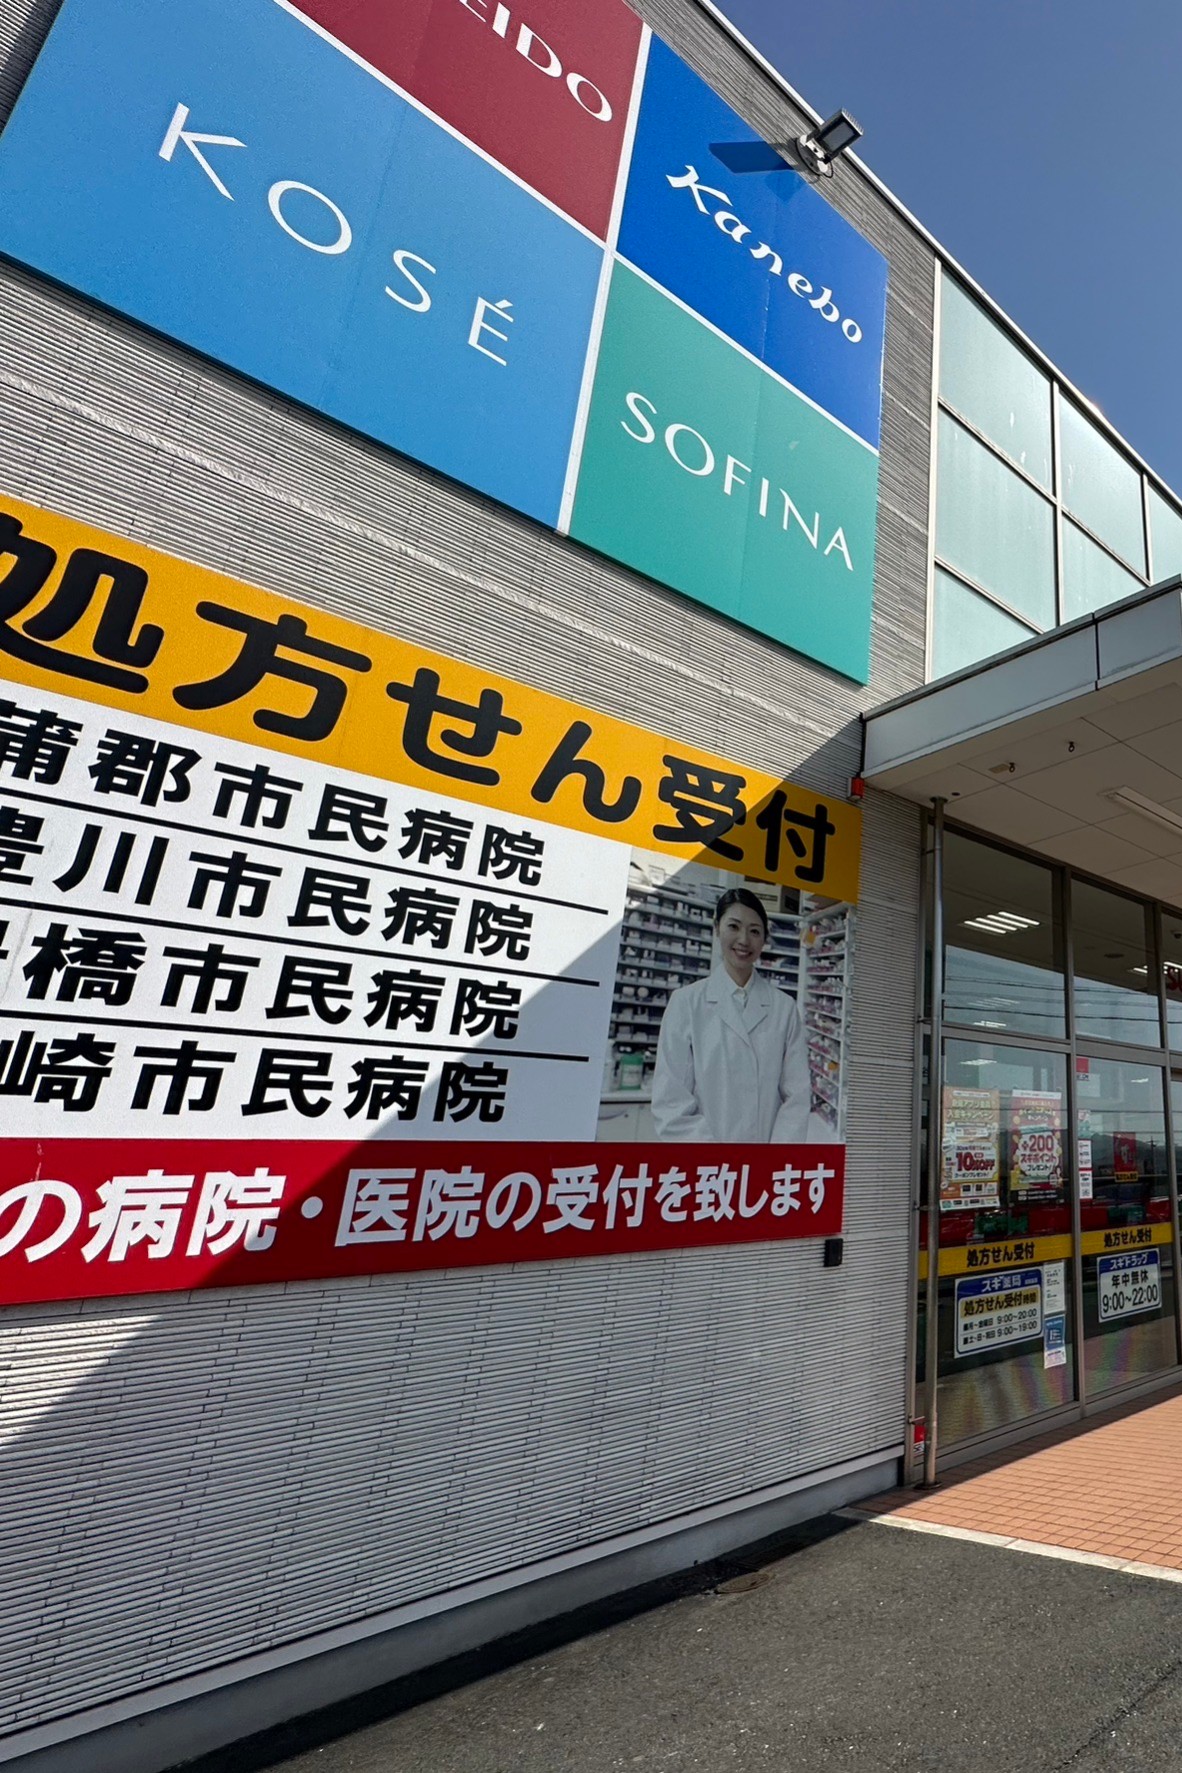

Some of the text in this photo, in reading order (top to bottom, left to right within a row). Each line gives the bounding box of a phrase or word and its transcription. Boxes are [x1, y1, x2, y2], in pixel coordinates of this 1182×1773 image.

[159, 103, 516, 367] KOSÉ
[666, 165, 863, 343] Kanebo
[621, 392, 854, 571] SOFINA
[0, 512, 836, 883] 処方せん受付
[0, 699, 545, 886] 蒲郡市民病院
[0, 920, 522, 1039] 橋市民病院
[0, 1162, 835, 1263] の病院・医院の受付を致します
[966, 1242, 1035, 1268] 処方せん受付
[1104, 1227, 1152, 1248] 処方せん受付
[1110, 1253, 1149, 1270] スギドラッグ
[982, 1274, 1022, 1293] スギ薬局
[1112, 1269, 1149, 1288] 年中無休
